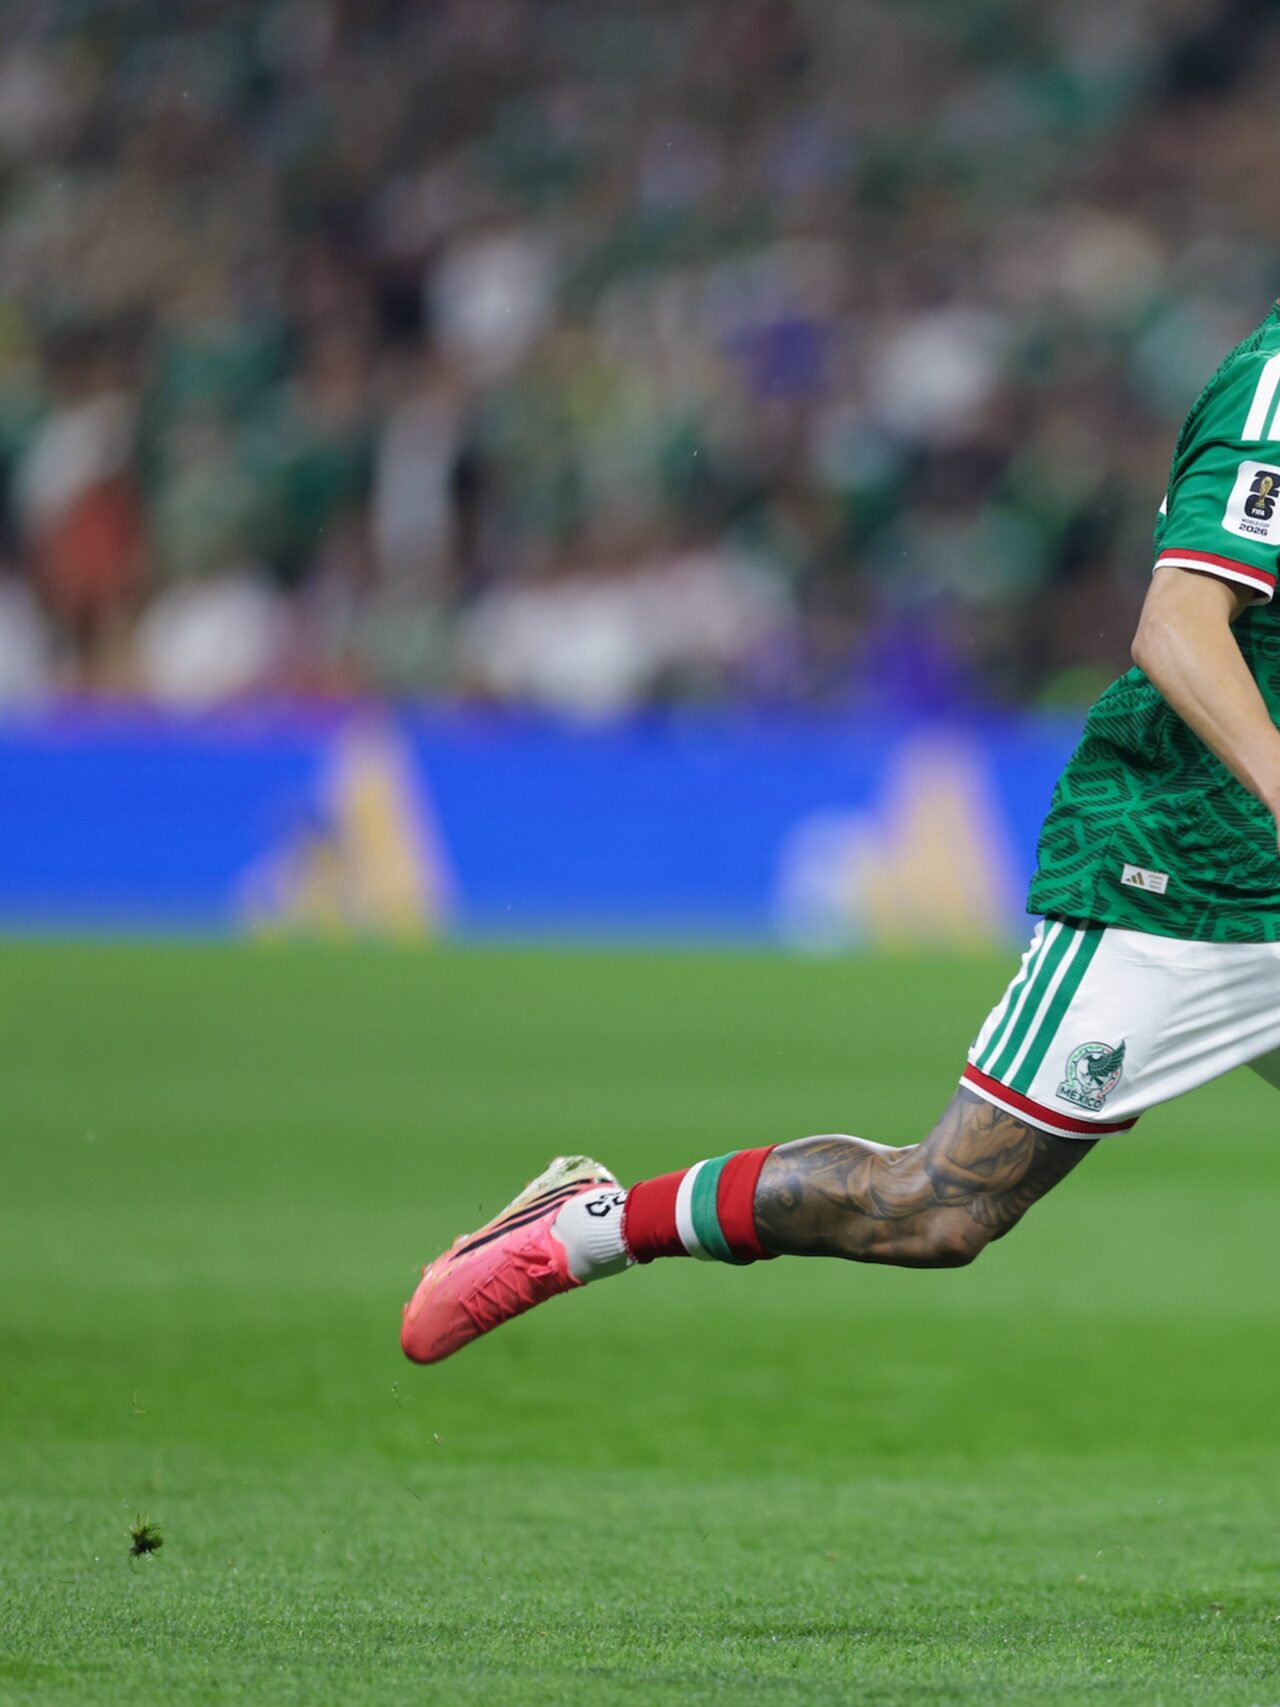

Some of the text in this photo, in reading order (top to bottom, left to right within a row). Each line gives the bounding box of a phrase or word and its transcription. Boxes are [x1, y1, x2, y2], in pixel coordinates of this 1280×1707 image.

[1251, 507, 1266, 517] FIFA
[1238, 523, 1268, 536] 2026
[1060, 1086, 1102, 1109] MEXICO
